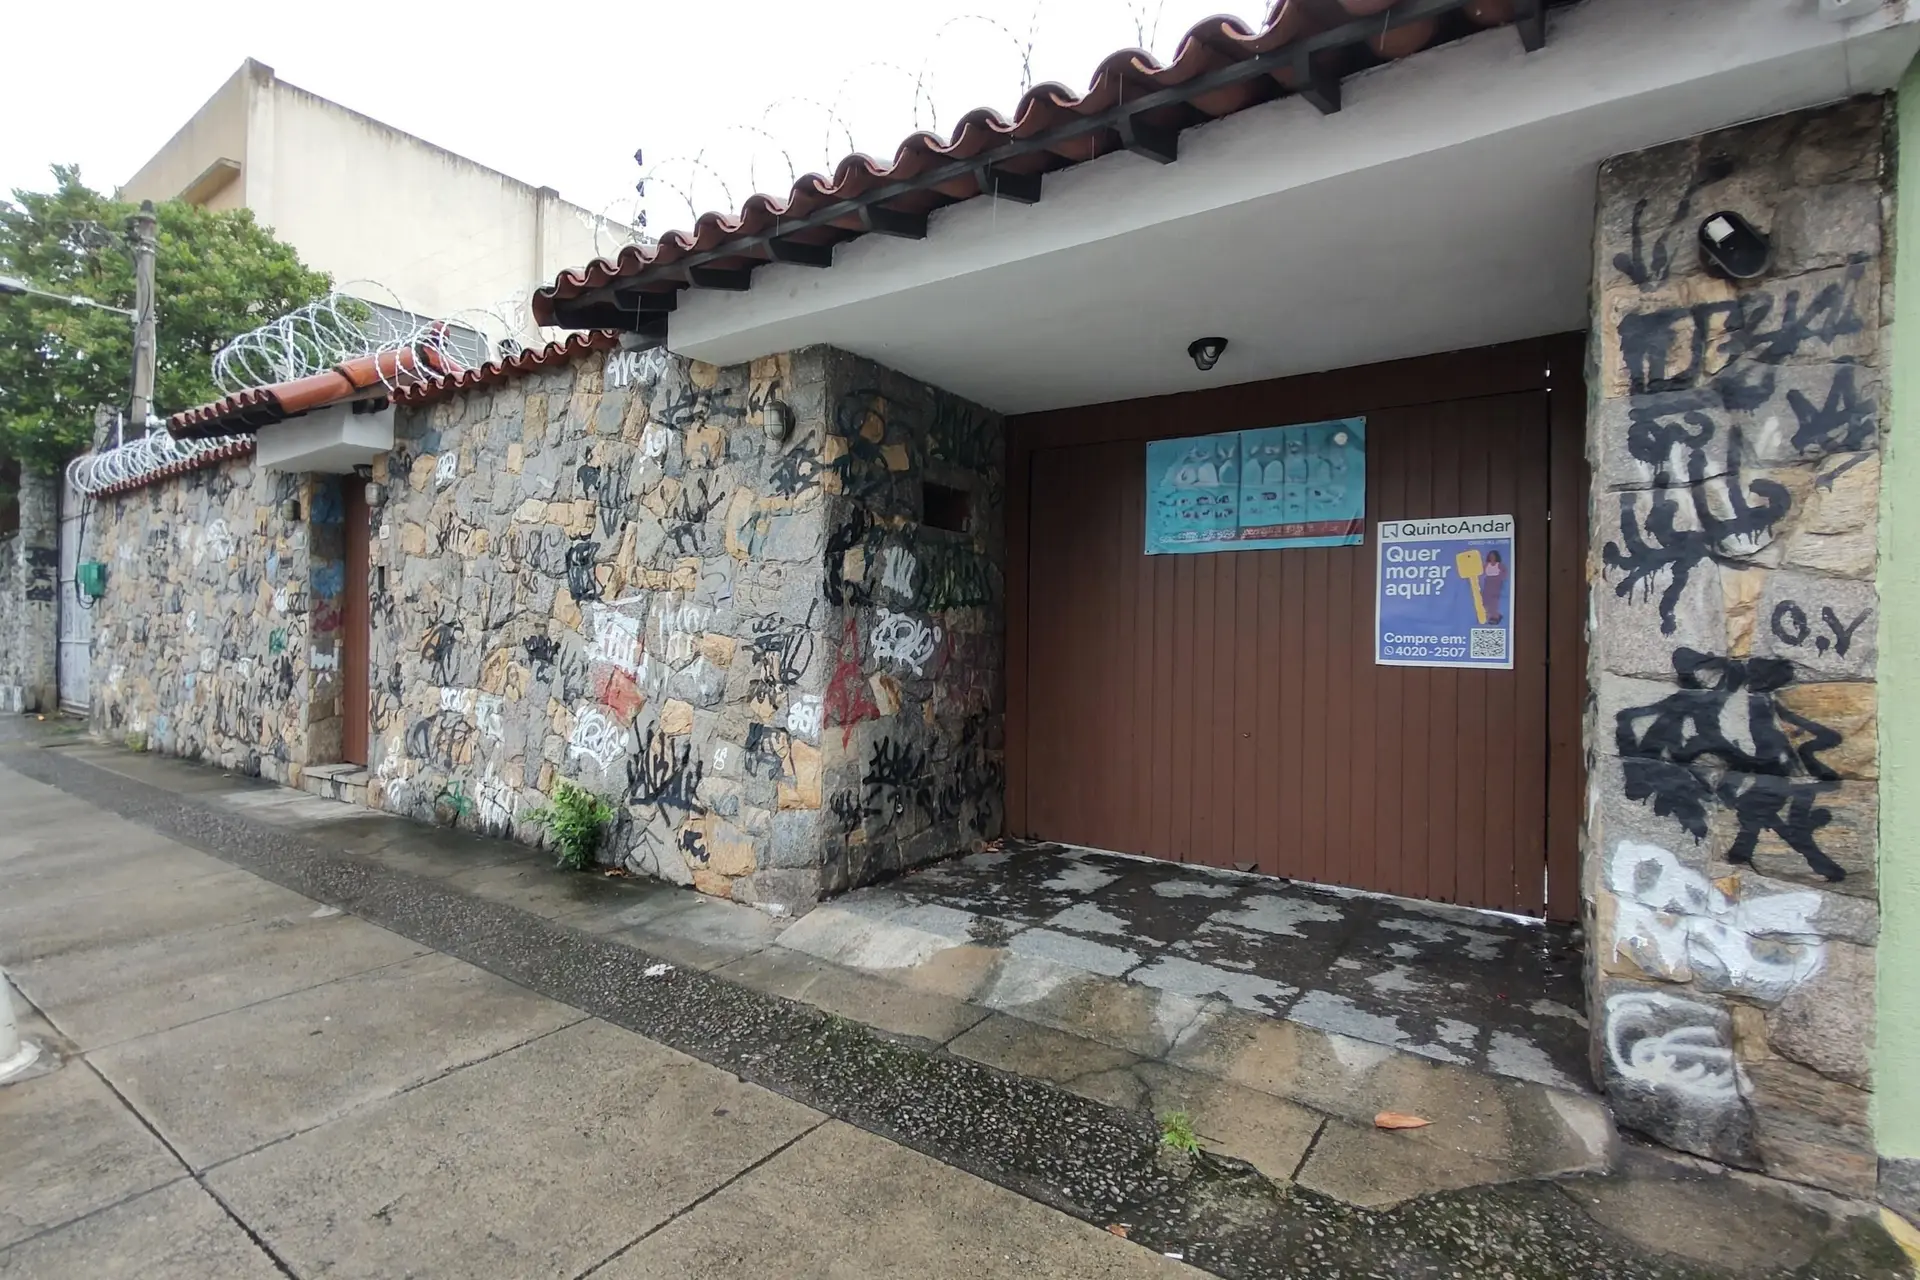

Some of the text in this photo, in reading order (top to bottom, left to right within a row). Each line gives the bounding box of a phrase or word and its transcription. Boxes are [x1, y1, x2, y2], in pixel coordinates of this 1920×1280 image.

[1402, 520, 1512, 537] QuintoAndar
[1386, 545, 1441, 562] Quer
[1386, 564, 1451, 579] morar
[1385, 579, 1445, 600] aqui?
[1383, 632, 1467, 645] Compre em:
[1395, 646, 1467, 658] 4020-2507
